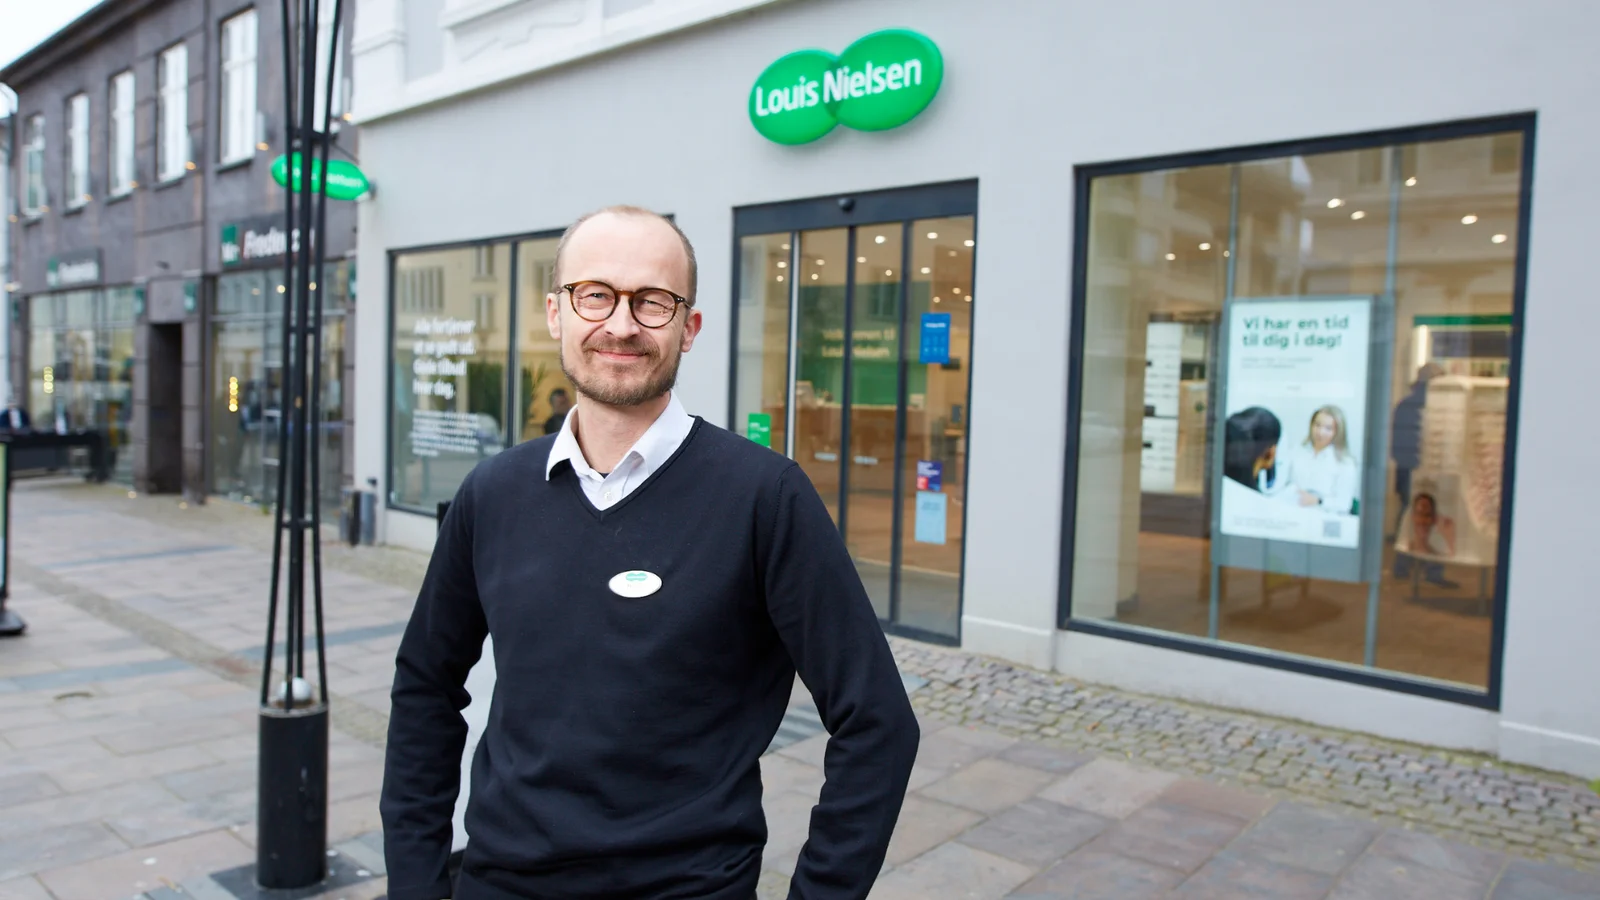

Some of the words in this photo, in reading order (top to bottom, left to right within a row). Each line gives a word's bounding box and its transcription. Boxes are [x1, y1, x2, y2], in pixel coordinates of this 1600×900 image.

[755, 75, 819, 117] Louis
[823, 58, 922, 103] Nielsen
[1243, 315, 1259, 330] Vi
[1264, 315, 1291, 330] har
[1298, 319, 1319, 330] en
[1325, 314, 1350, 330] tid
[1243, 333, 1259, 346] til
[1263, 332, 1289, 349] dig
[1304, 332, 1342, 349] dag!
